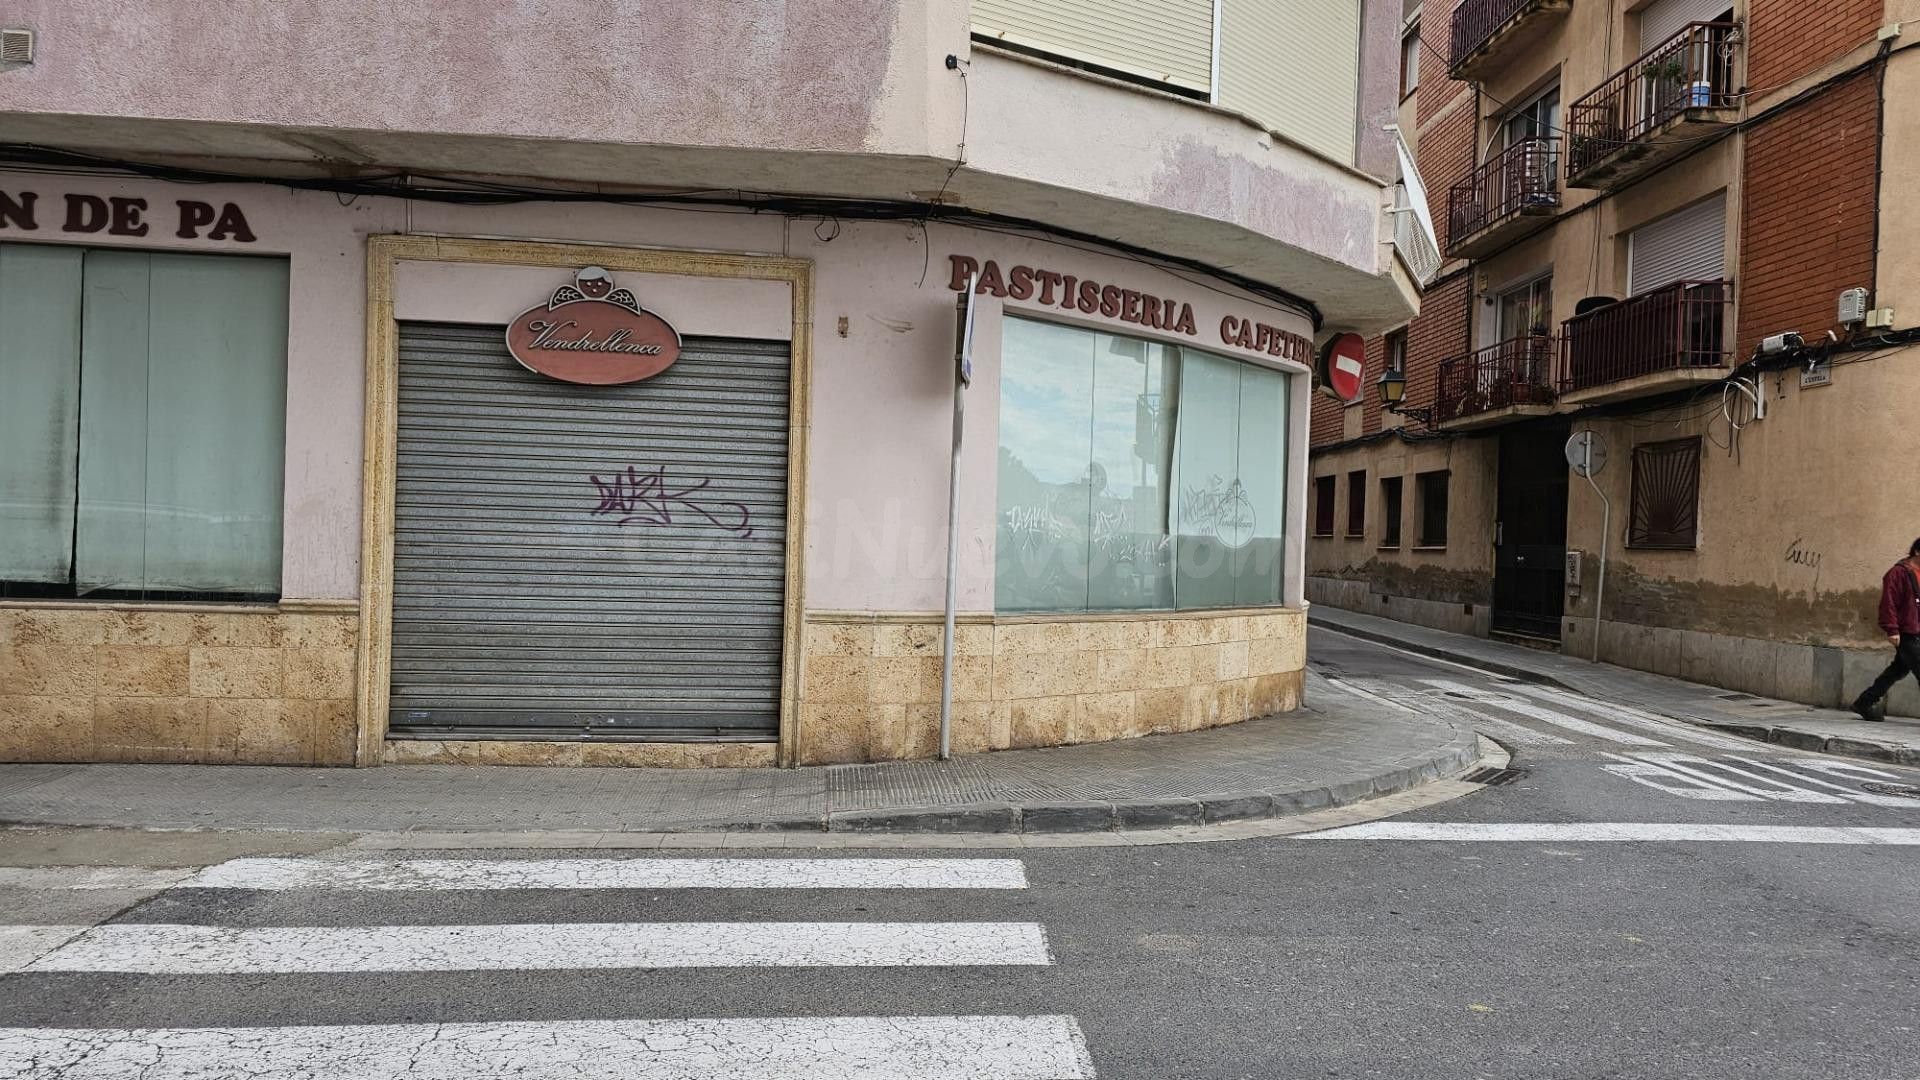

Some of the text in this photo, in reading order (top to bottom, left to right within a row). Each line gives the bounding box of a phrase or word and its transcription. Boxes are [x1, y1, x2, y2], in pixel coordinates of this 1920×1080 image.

[62, 193, 149, 237] DE
[175, 200, 257, 243] PA
[949, 254, 1198, 335] PASTISSERIA
[529, 319, 663, 356] Vendrellenca
